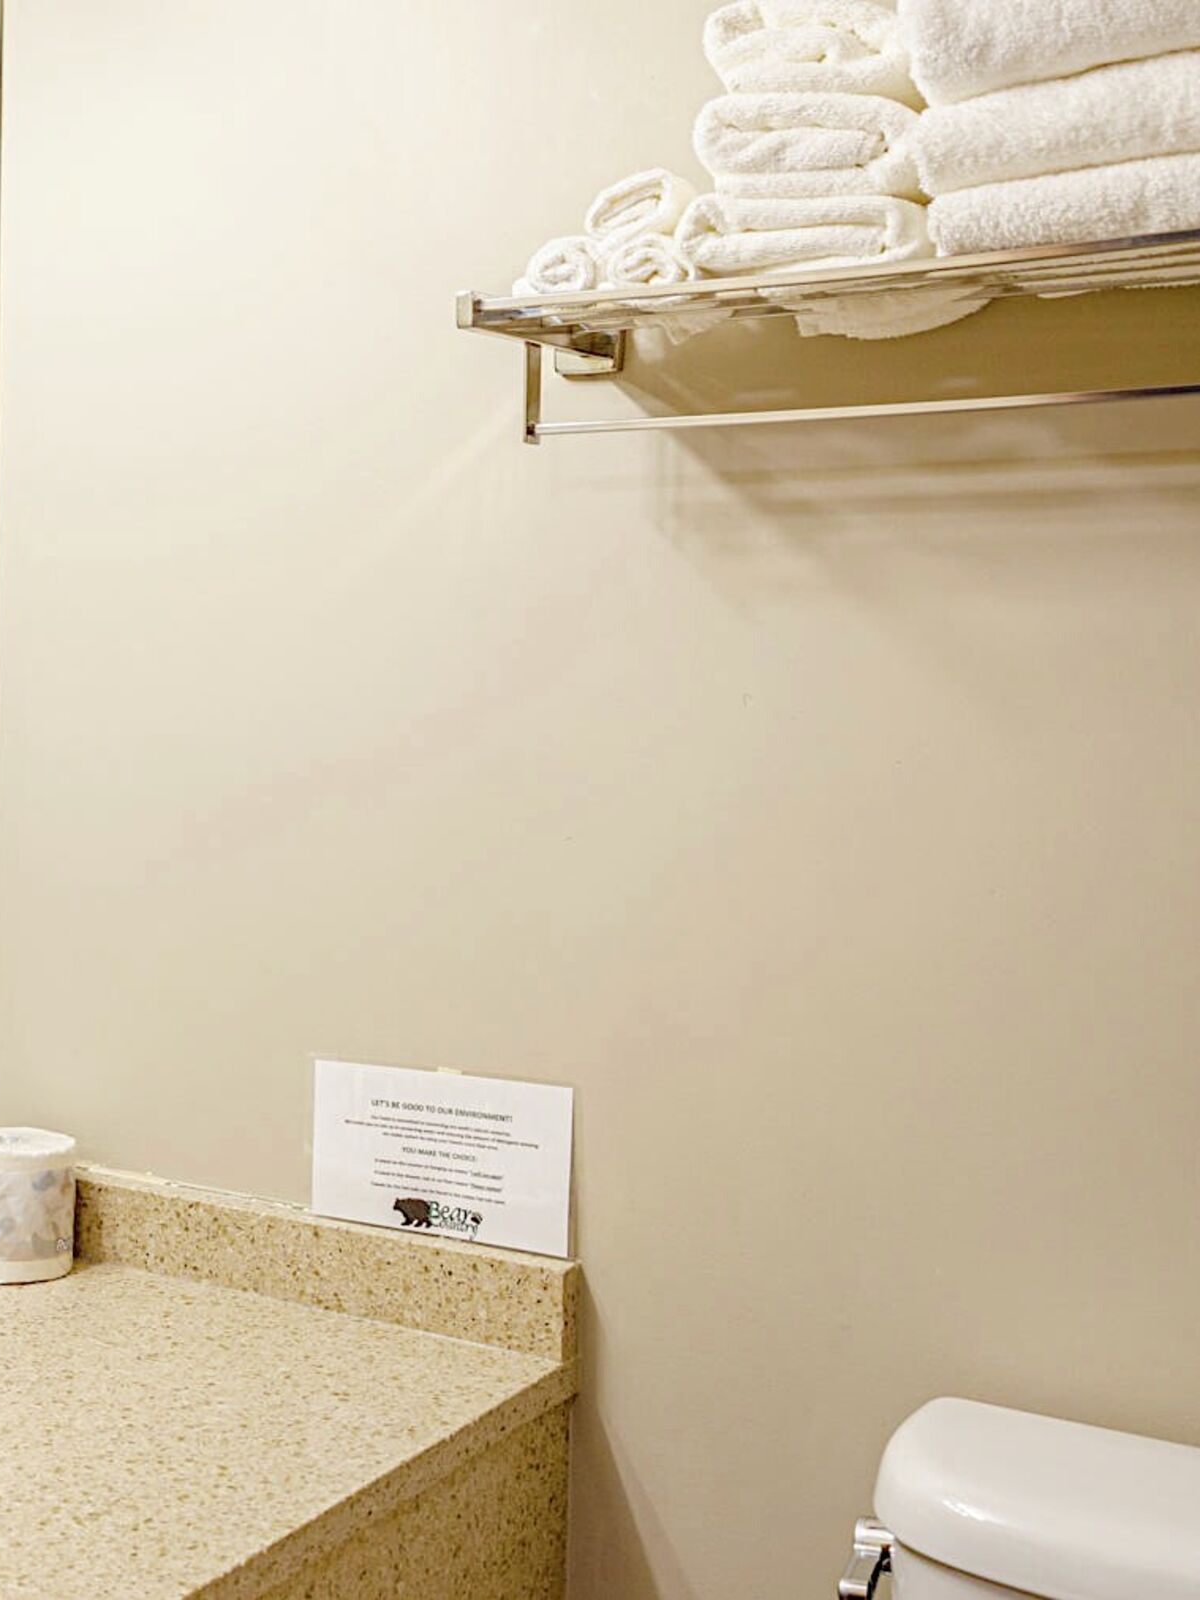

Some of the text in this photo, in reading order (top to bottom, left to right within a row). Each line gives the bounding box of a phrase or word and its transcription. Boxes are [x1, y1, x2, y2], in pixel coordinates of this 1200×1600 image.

[371, 1099, 390, 1108] LET'S
[392, 1101, 400, 1109] BE
[402, 1102, 424, 1112] GOOD
[426, 1105, 435, 1114] TO
[437, 1106, 454, 1115] OUR
[402, 1146, 416, 1154] YOU
[418, 1148, 436, 1157] MAKE
[438, 1150, 450, 1159] THE
[429, 1200, 472, 1224] Bear
